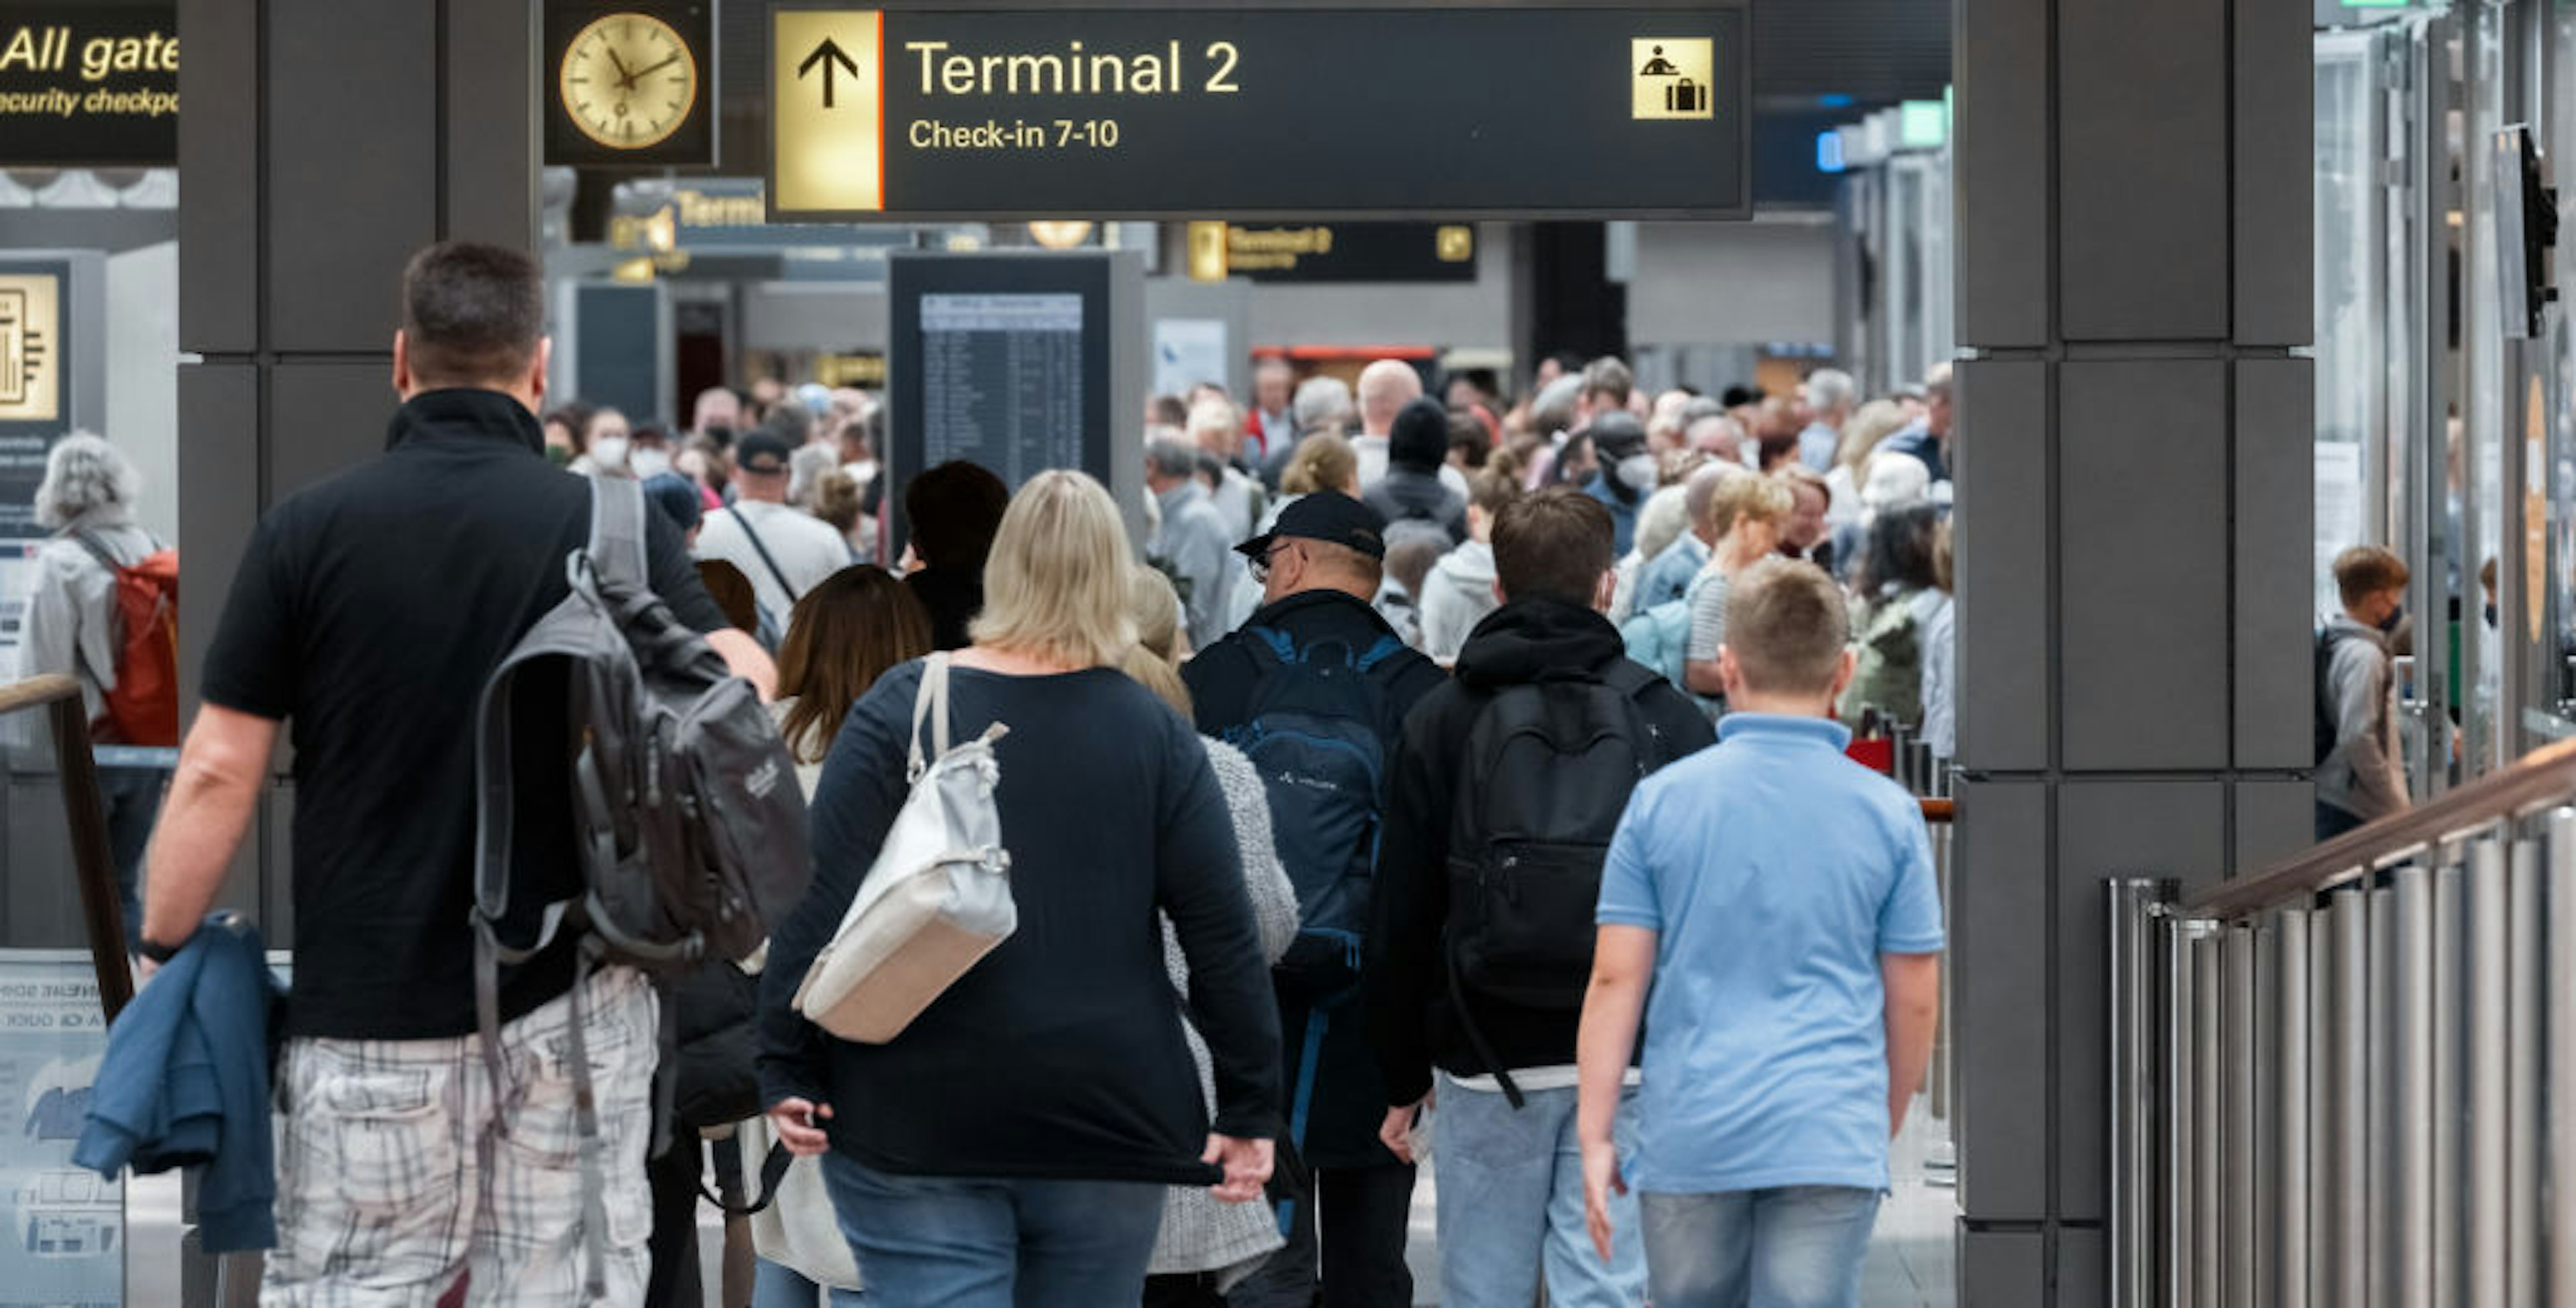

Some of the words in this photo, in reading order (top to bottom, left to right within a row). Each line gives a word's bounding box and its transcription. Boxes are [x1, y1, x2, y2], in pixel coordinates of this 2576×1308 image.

[0, 27, 70, 70] All
[905, 40, 1180, 94] Terminal
[1205, 41, 1240, 93] 2
[909, 119, 1046, 148] Check-in
[1053, 119, 1119, 148] 7-10
